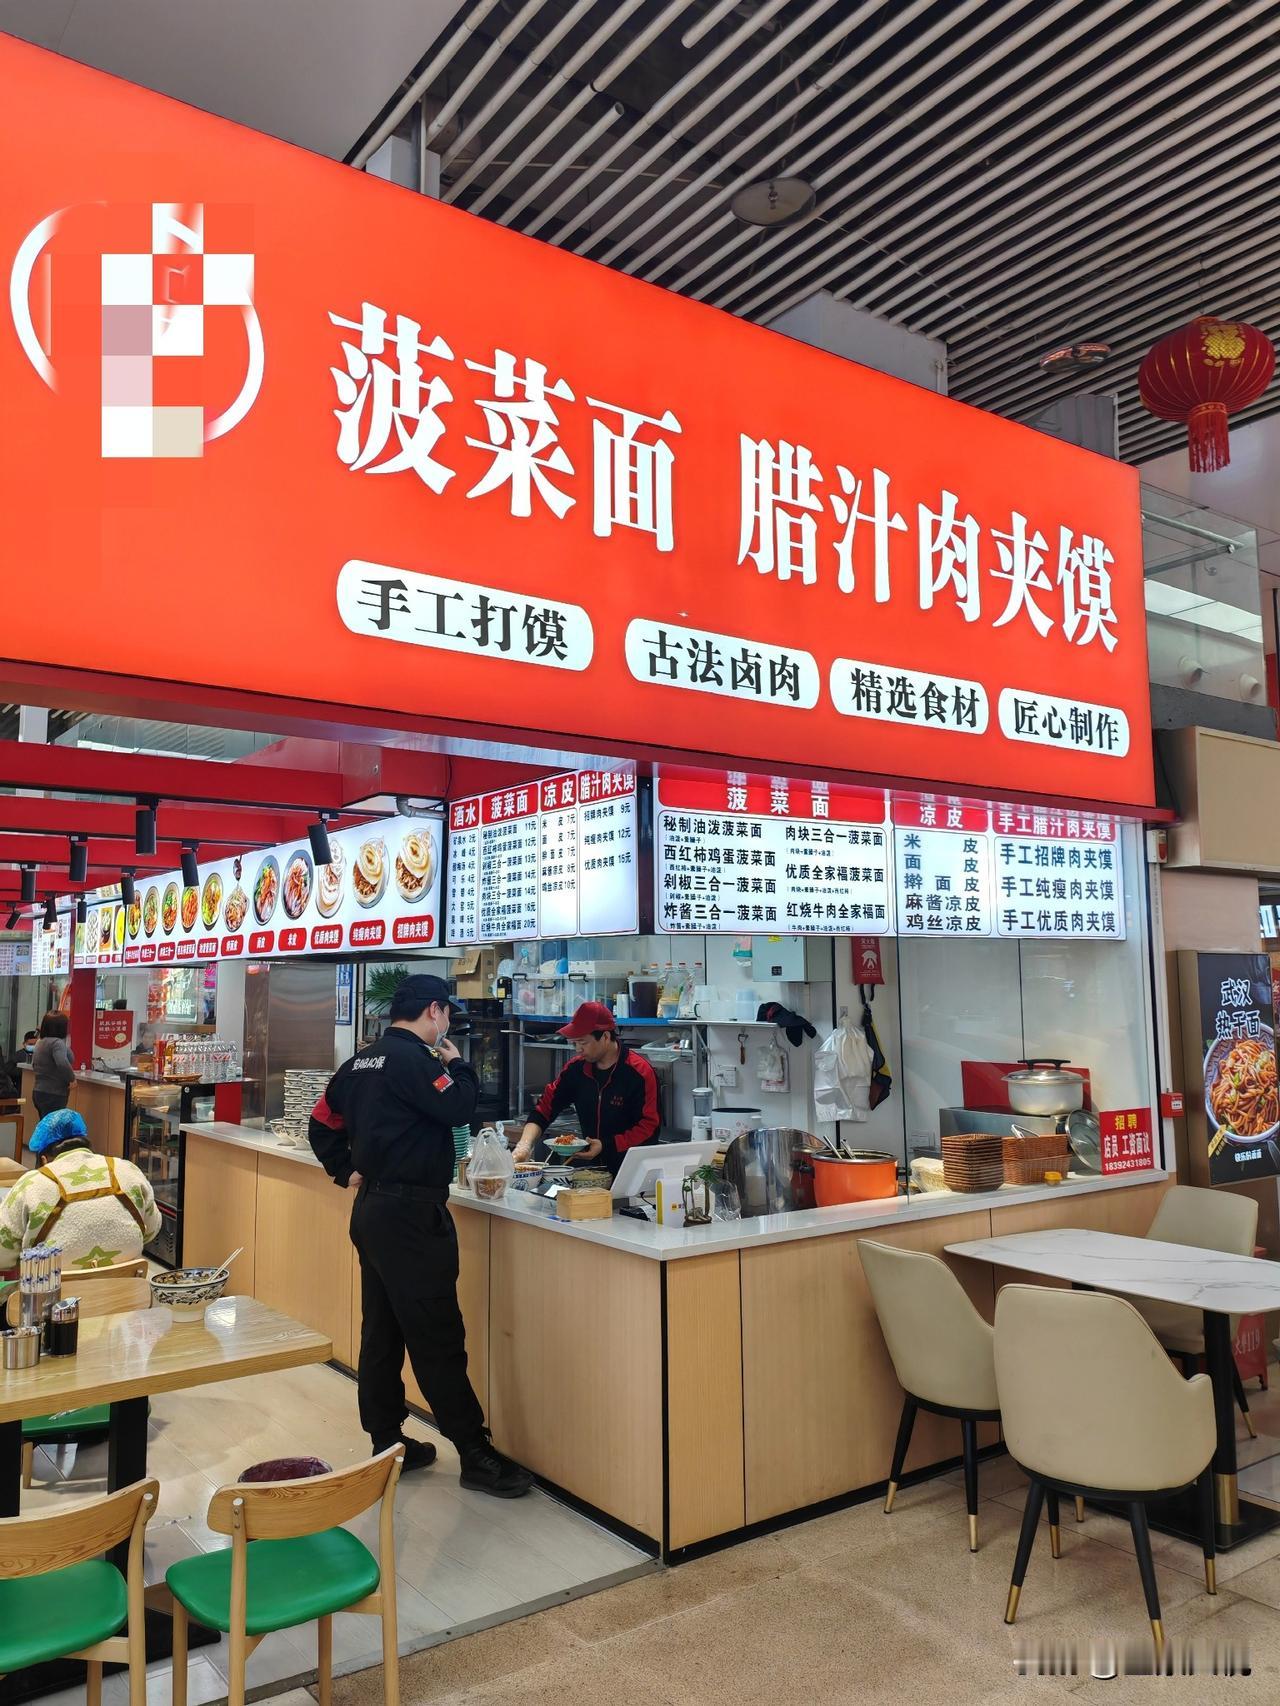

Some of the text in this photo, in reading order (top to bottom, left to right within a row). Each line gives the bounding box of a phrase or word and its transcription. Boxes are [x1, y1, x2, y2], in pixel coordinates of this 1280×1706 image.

[327, 301, 1119, 653] 菠菜面 腊汁肉夹馍
[358, 579, 569, 664] 手工打馍
[643, 631, 802, 702] 古法卤肉
[850, 668, 981, 730] 精选食材
[1013, 699, 1121, 750] 匠心制作
[544, 778, 575, 807] 凉皮
[727, 787, 830, 818] 菠菜面
[491, 789, 529, 820] 菠菜面
[621, 803, 631, 813] 9元
[663, 815, 762, 838] 秘制油泼菠菜面
[920, 804, 963, 829] 凉皮
[998, 813, 1112, 840] 手工腊汁肉夹馍
[618, 827, 631, 838] 12元
[785, 825, 883, 846] 肉块三合一菠菜面
[618, 852, 631, 863] 15元
[664, 844, 776, 867] 西红柿鸡蛋菠菜面
[1000, 843, 1113, 870] 手工招牌肉夹馍
[664, 873, 776, 894] 剁椒三合一菠菜面
[785, 863, 884, 882] 优质全家福菠菜面
[1001, 876, 1114, 900] 手工纯瘦肉夹馍
[664, 902, 777, 921] 炸酱三合一菠菜面
[786, 902, 885, 919] 红烧牛肉全家福面
[905, 893, 981, 912] 麻酱凉皮
[352, 923, 382, 940] 纯瘦肉夹馍
[397, 920, 428, 939] 招牌肉夹馍
[906, 914, 982, 932] 鸡丝凉皮
[1002, 909, 1115, 932] 手工优质肉夹馍
[1221, 977, 1253, 1007] 武汉
[1215, 1010, 1260, 1040] 热干面
[1115, 1113, 1137, 1130] 招聘
[1104, 1134, 1118, 1158] 店员
